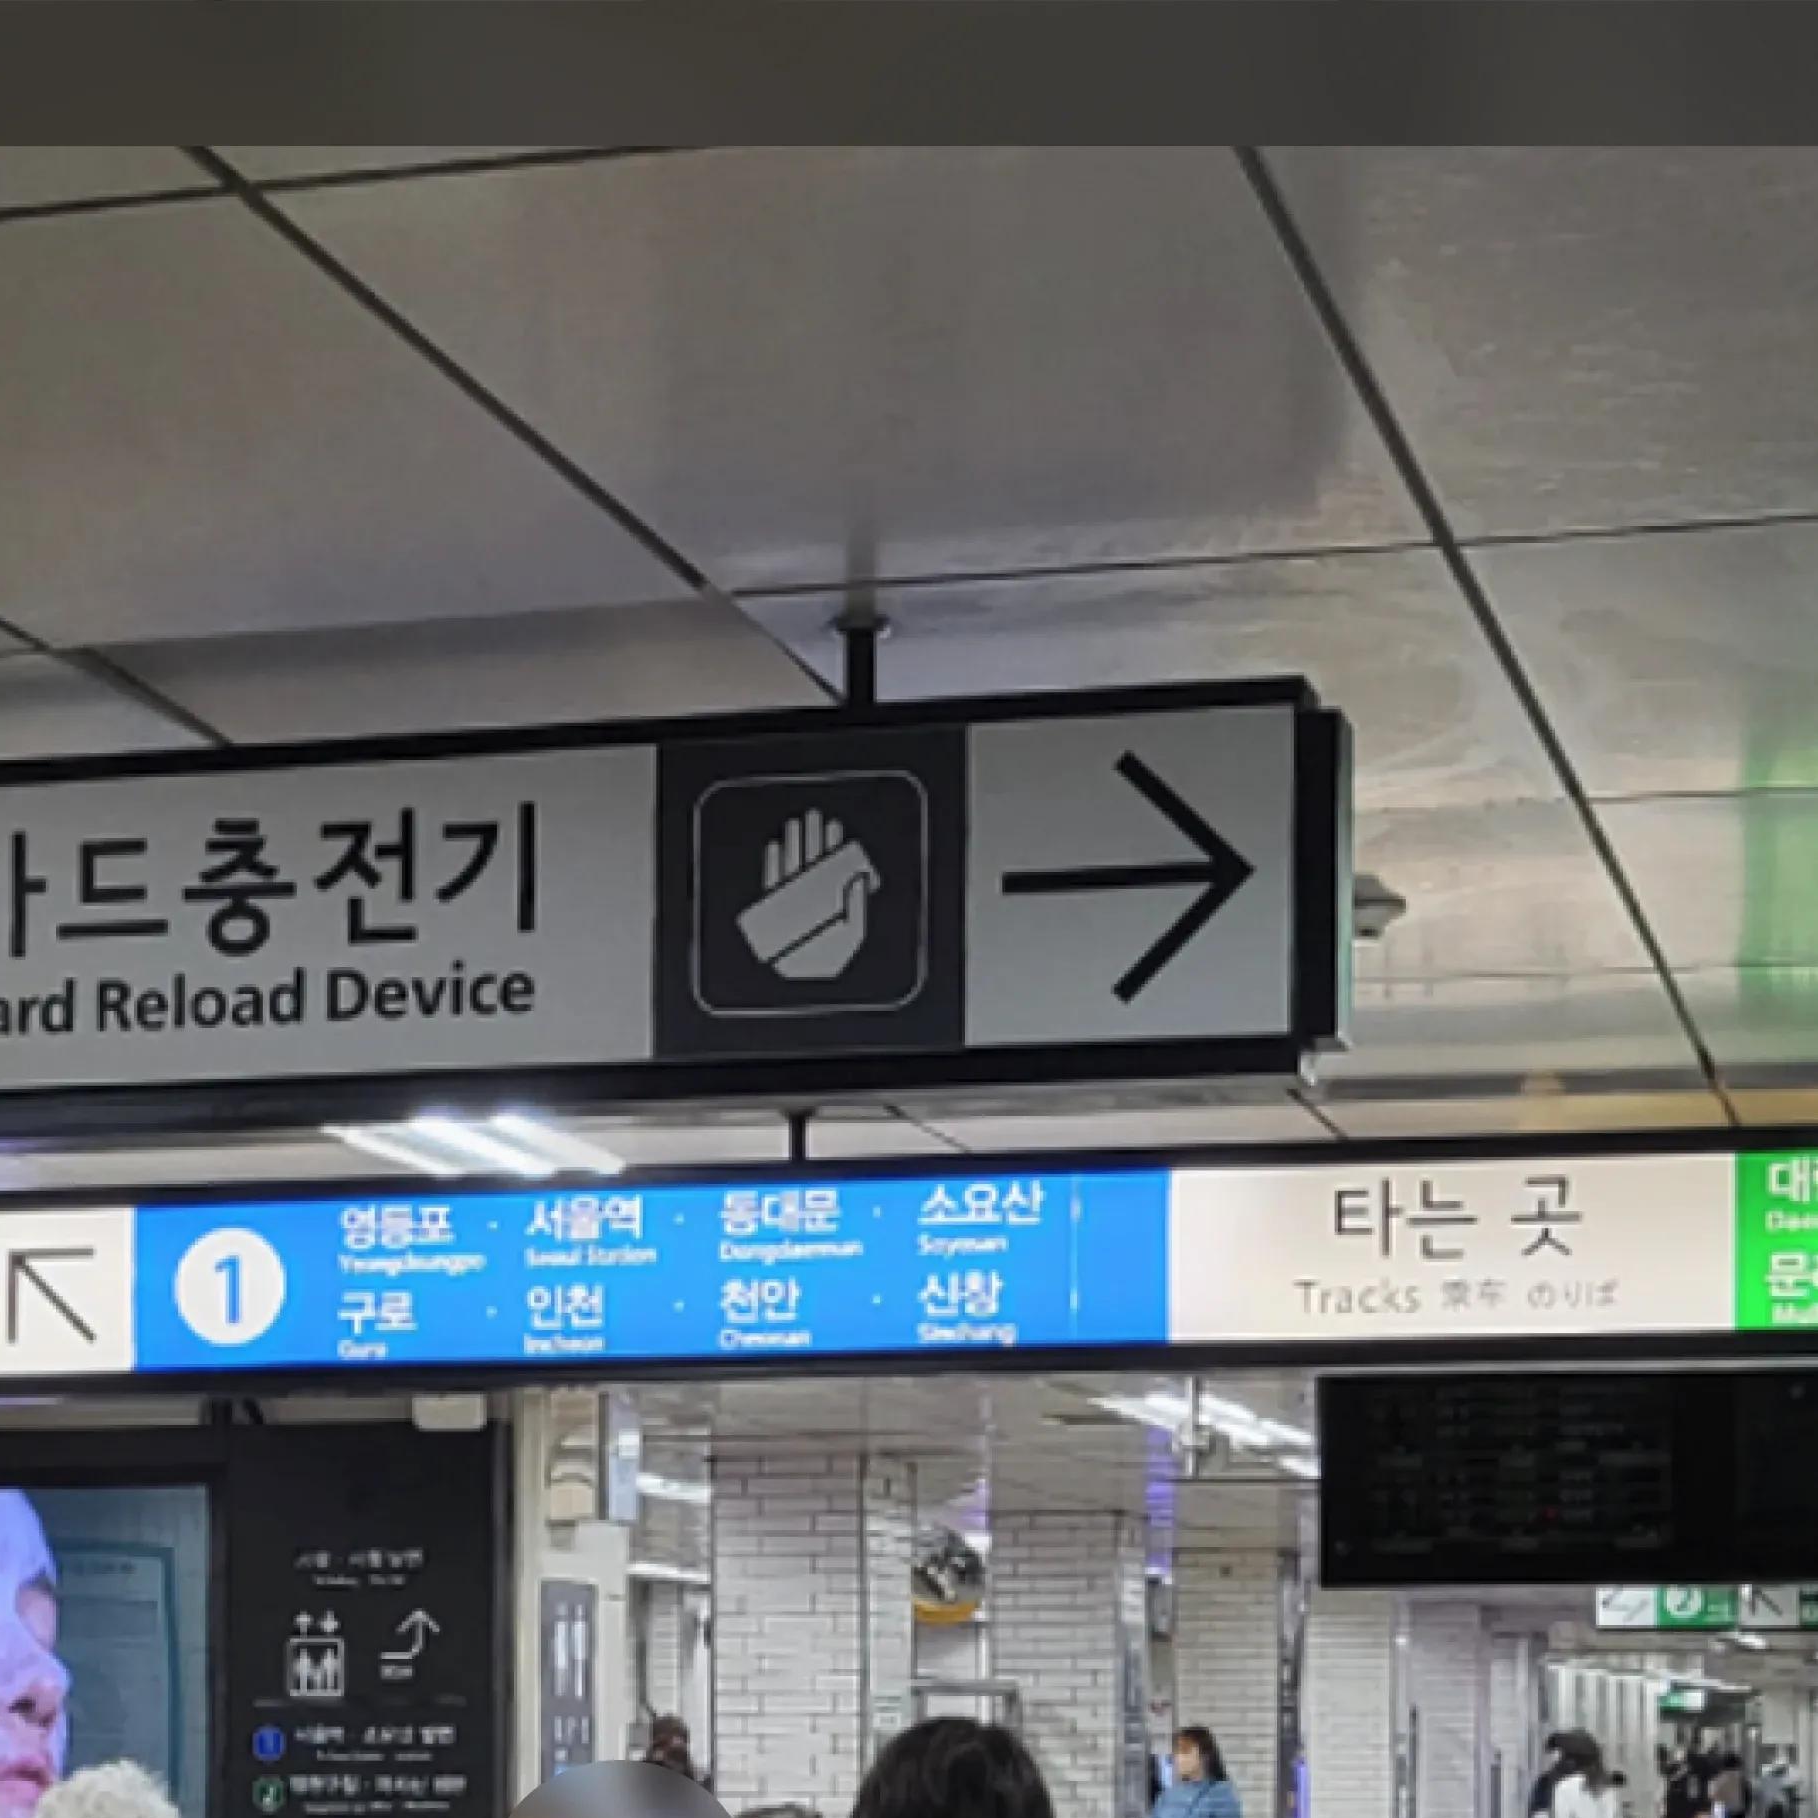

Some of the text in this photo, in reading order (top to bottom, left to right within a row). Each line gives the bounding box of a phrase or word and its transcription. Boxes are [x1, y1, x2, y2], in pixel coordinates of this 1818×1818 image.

[96, 965, 307, 1032] Reload
[325, 959, 536, 1023] Device
[340, 1179, 1046, 1250] 영등포 서울역 동대문 소요산
[1767, 1157, 1818, 1203] 대
[1334, 1175, 1584, 1260] 타는 곳
[214, 1253, 242, 1325] 1
[338, 1269, 1005, 1336] 구로 인천 천안 신창
[1293, 1278, 1423, 1314] Tracks
